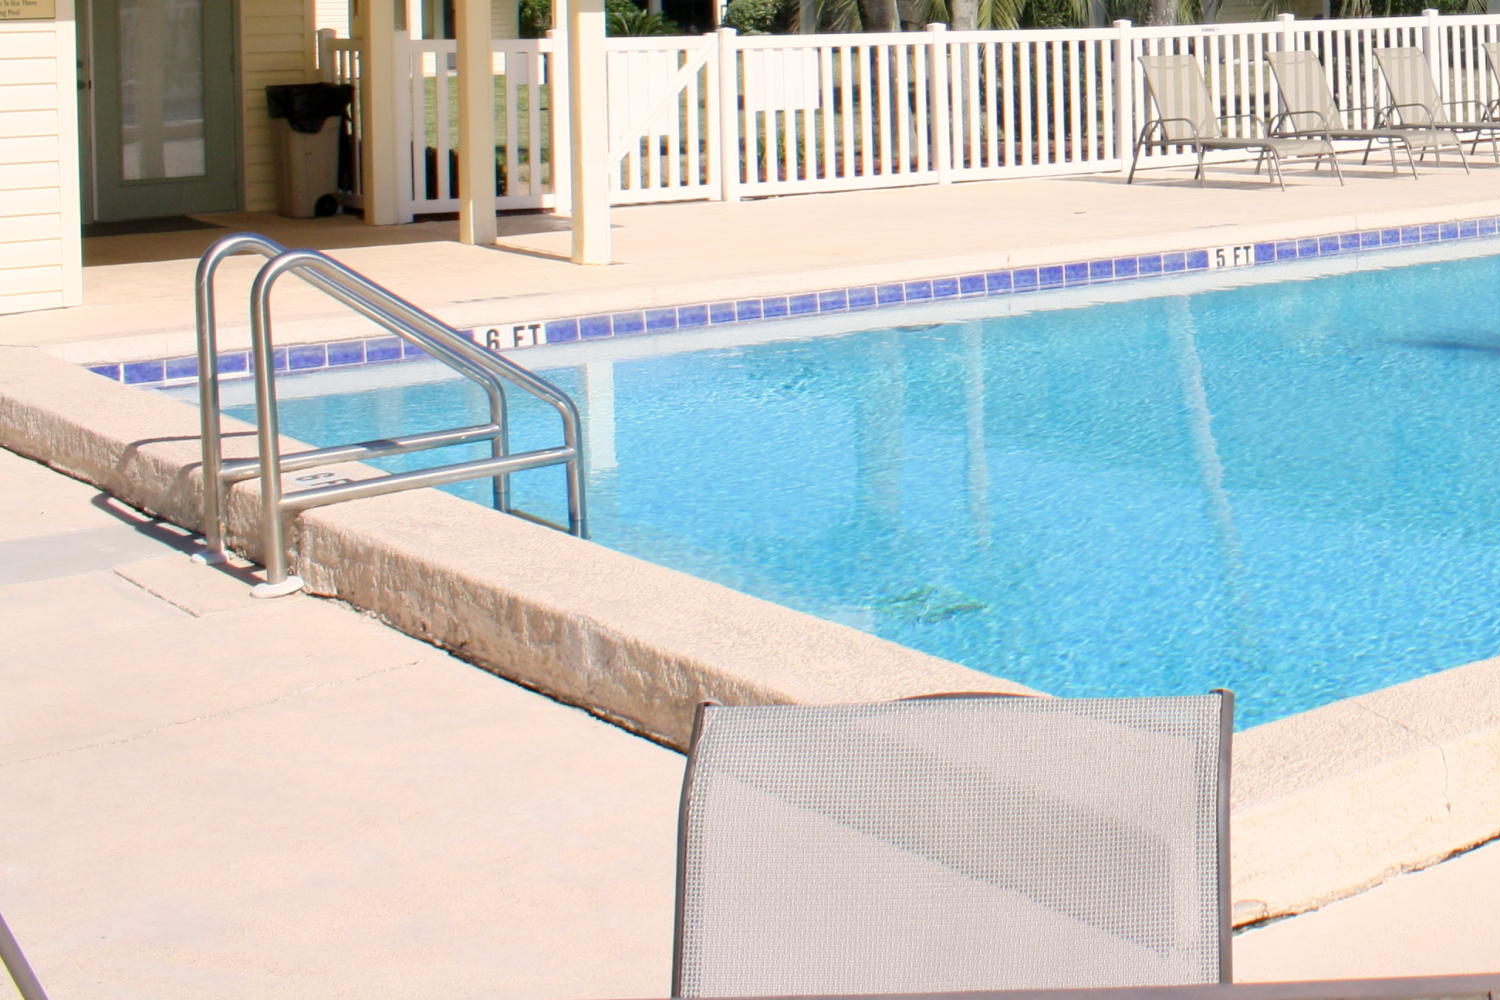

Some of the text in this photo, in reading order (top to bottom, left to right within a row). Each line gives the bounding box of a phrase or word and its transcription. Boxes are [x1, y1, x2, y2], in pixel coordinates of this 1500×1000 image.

[1216, 245, 1251, 267] 5 FT
[486, 324, 540, 351] 6 FT
